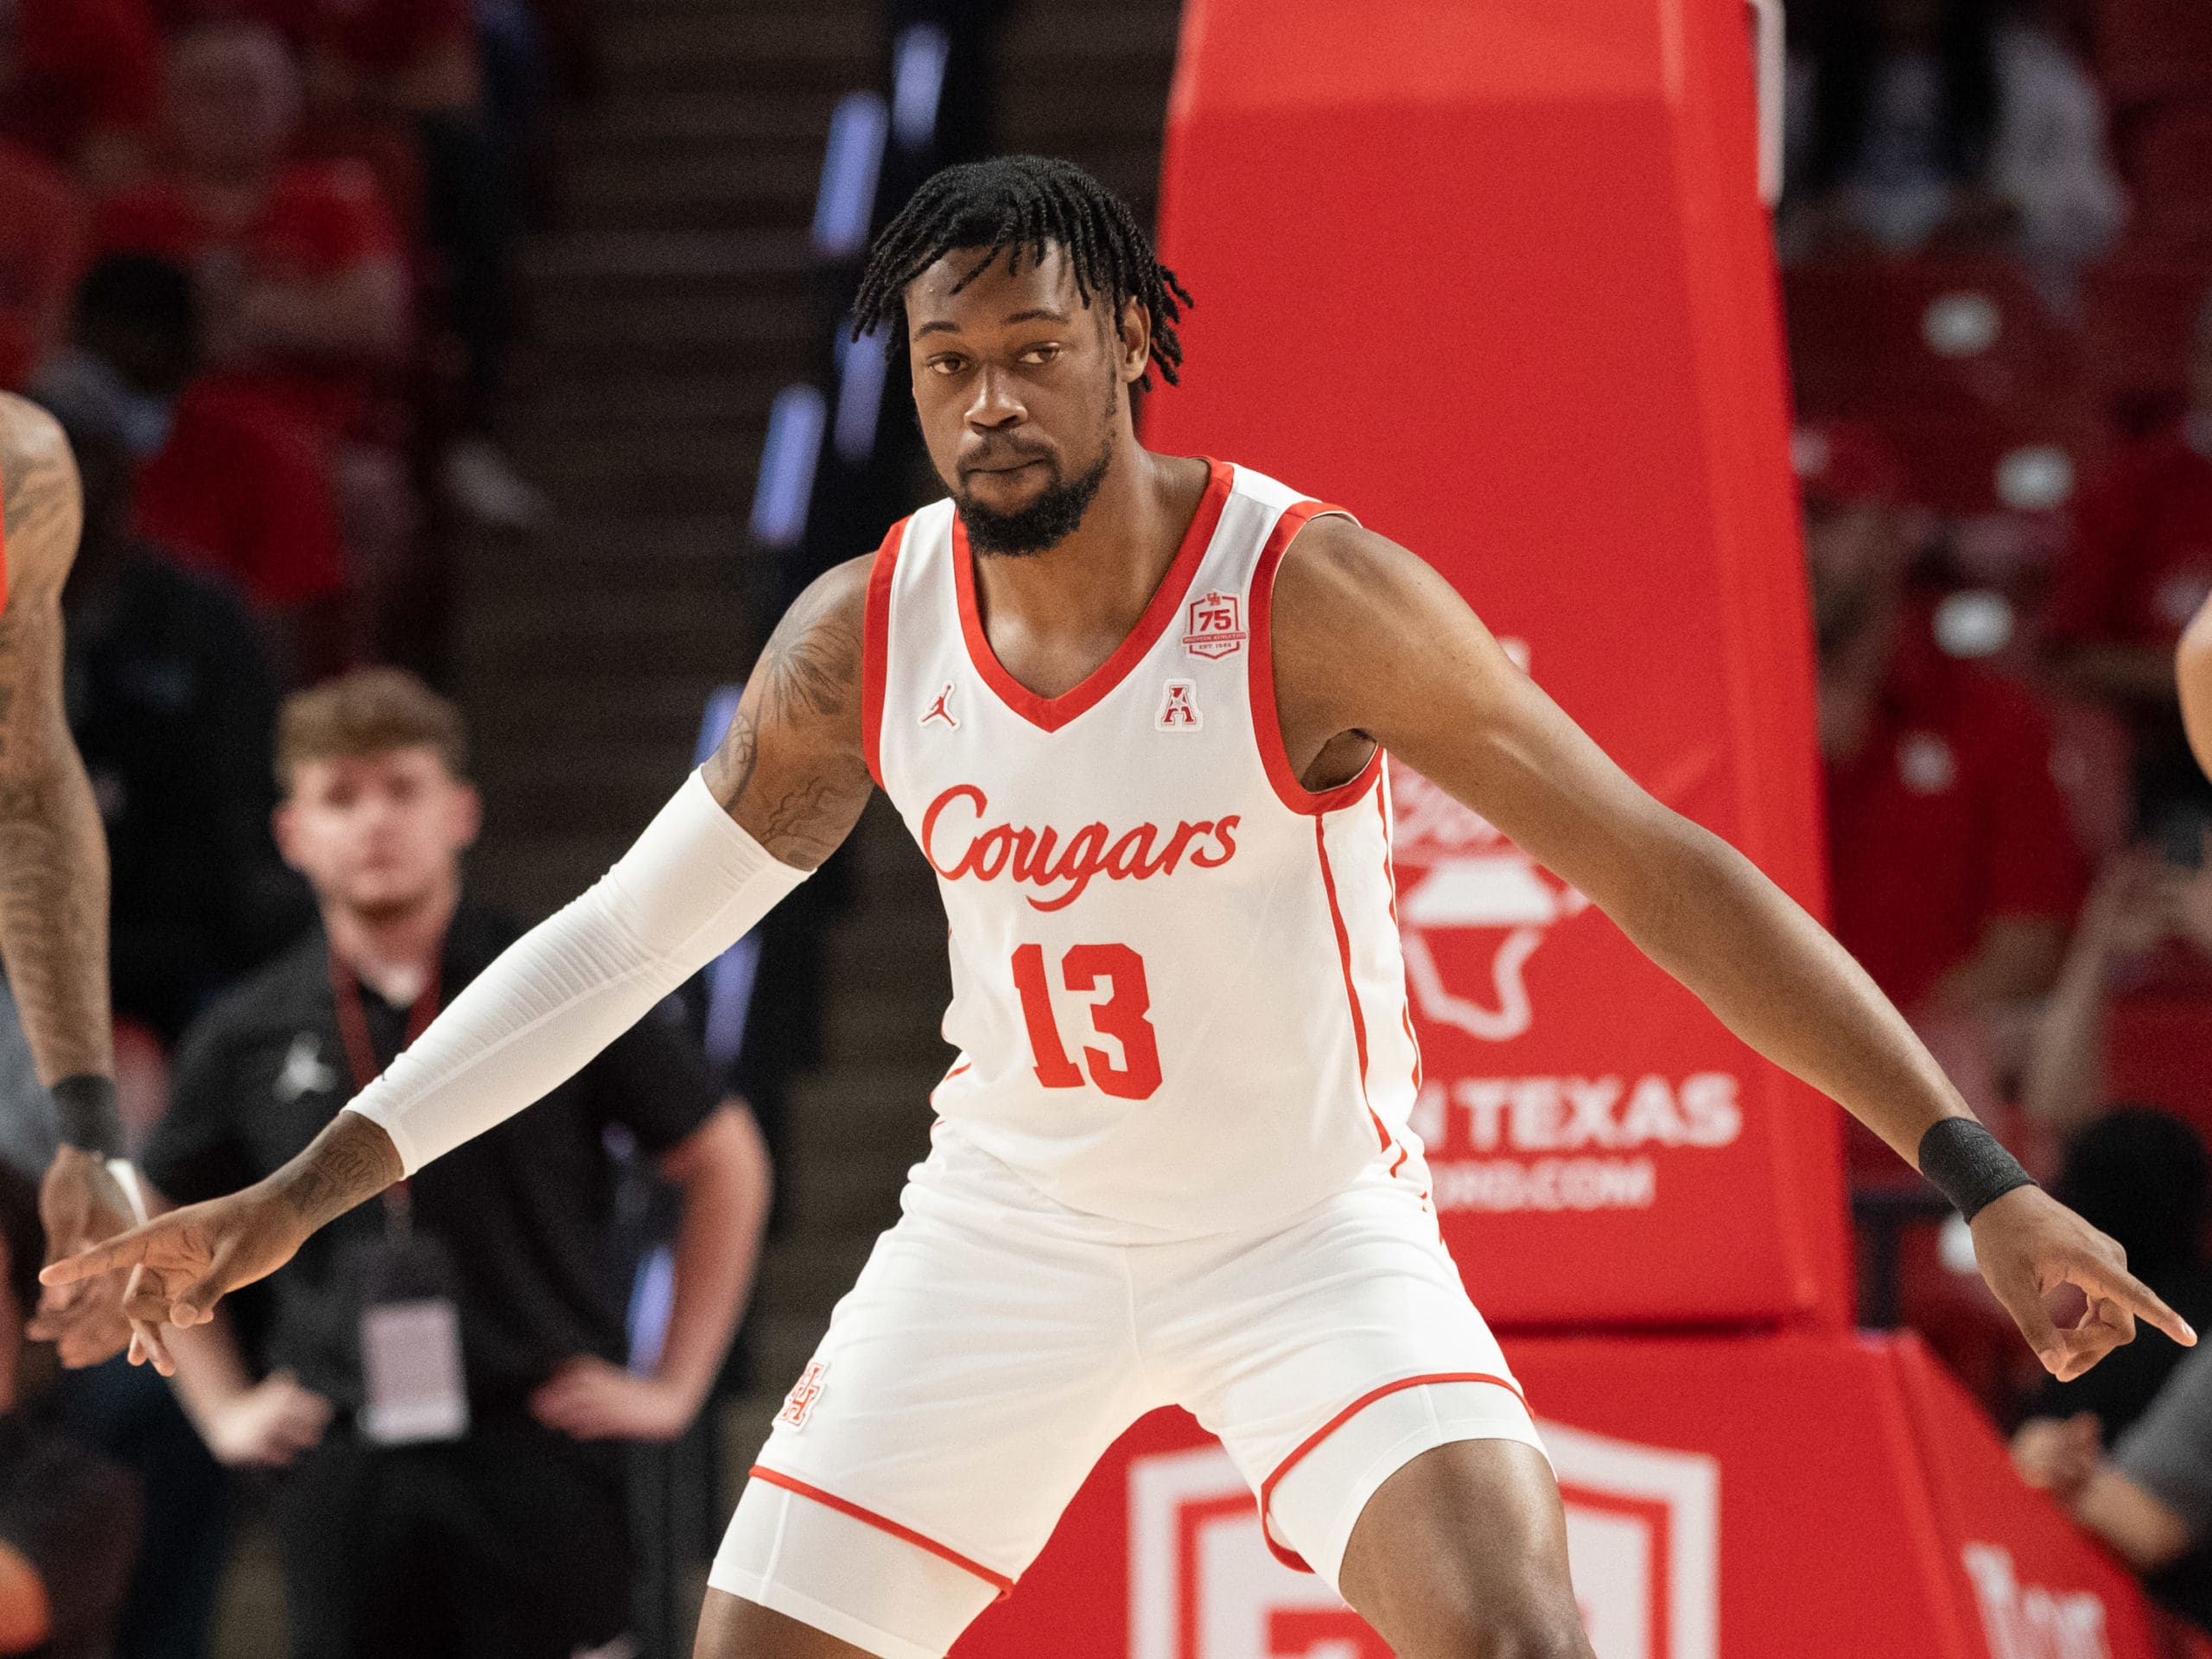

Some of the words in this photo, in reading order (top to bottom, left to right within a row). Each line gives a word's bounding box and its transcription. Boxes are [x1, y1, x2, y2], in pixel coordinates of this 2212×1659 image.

[1198, 608, 1232, 632] 75
[1161, 683, 1197, 726] A
[921, 784, 1242, 912] Cougars
[1011, 943, 1163, 1100] 13
[1452, 1071, 1744, 1152] TEXAS
